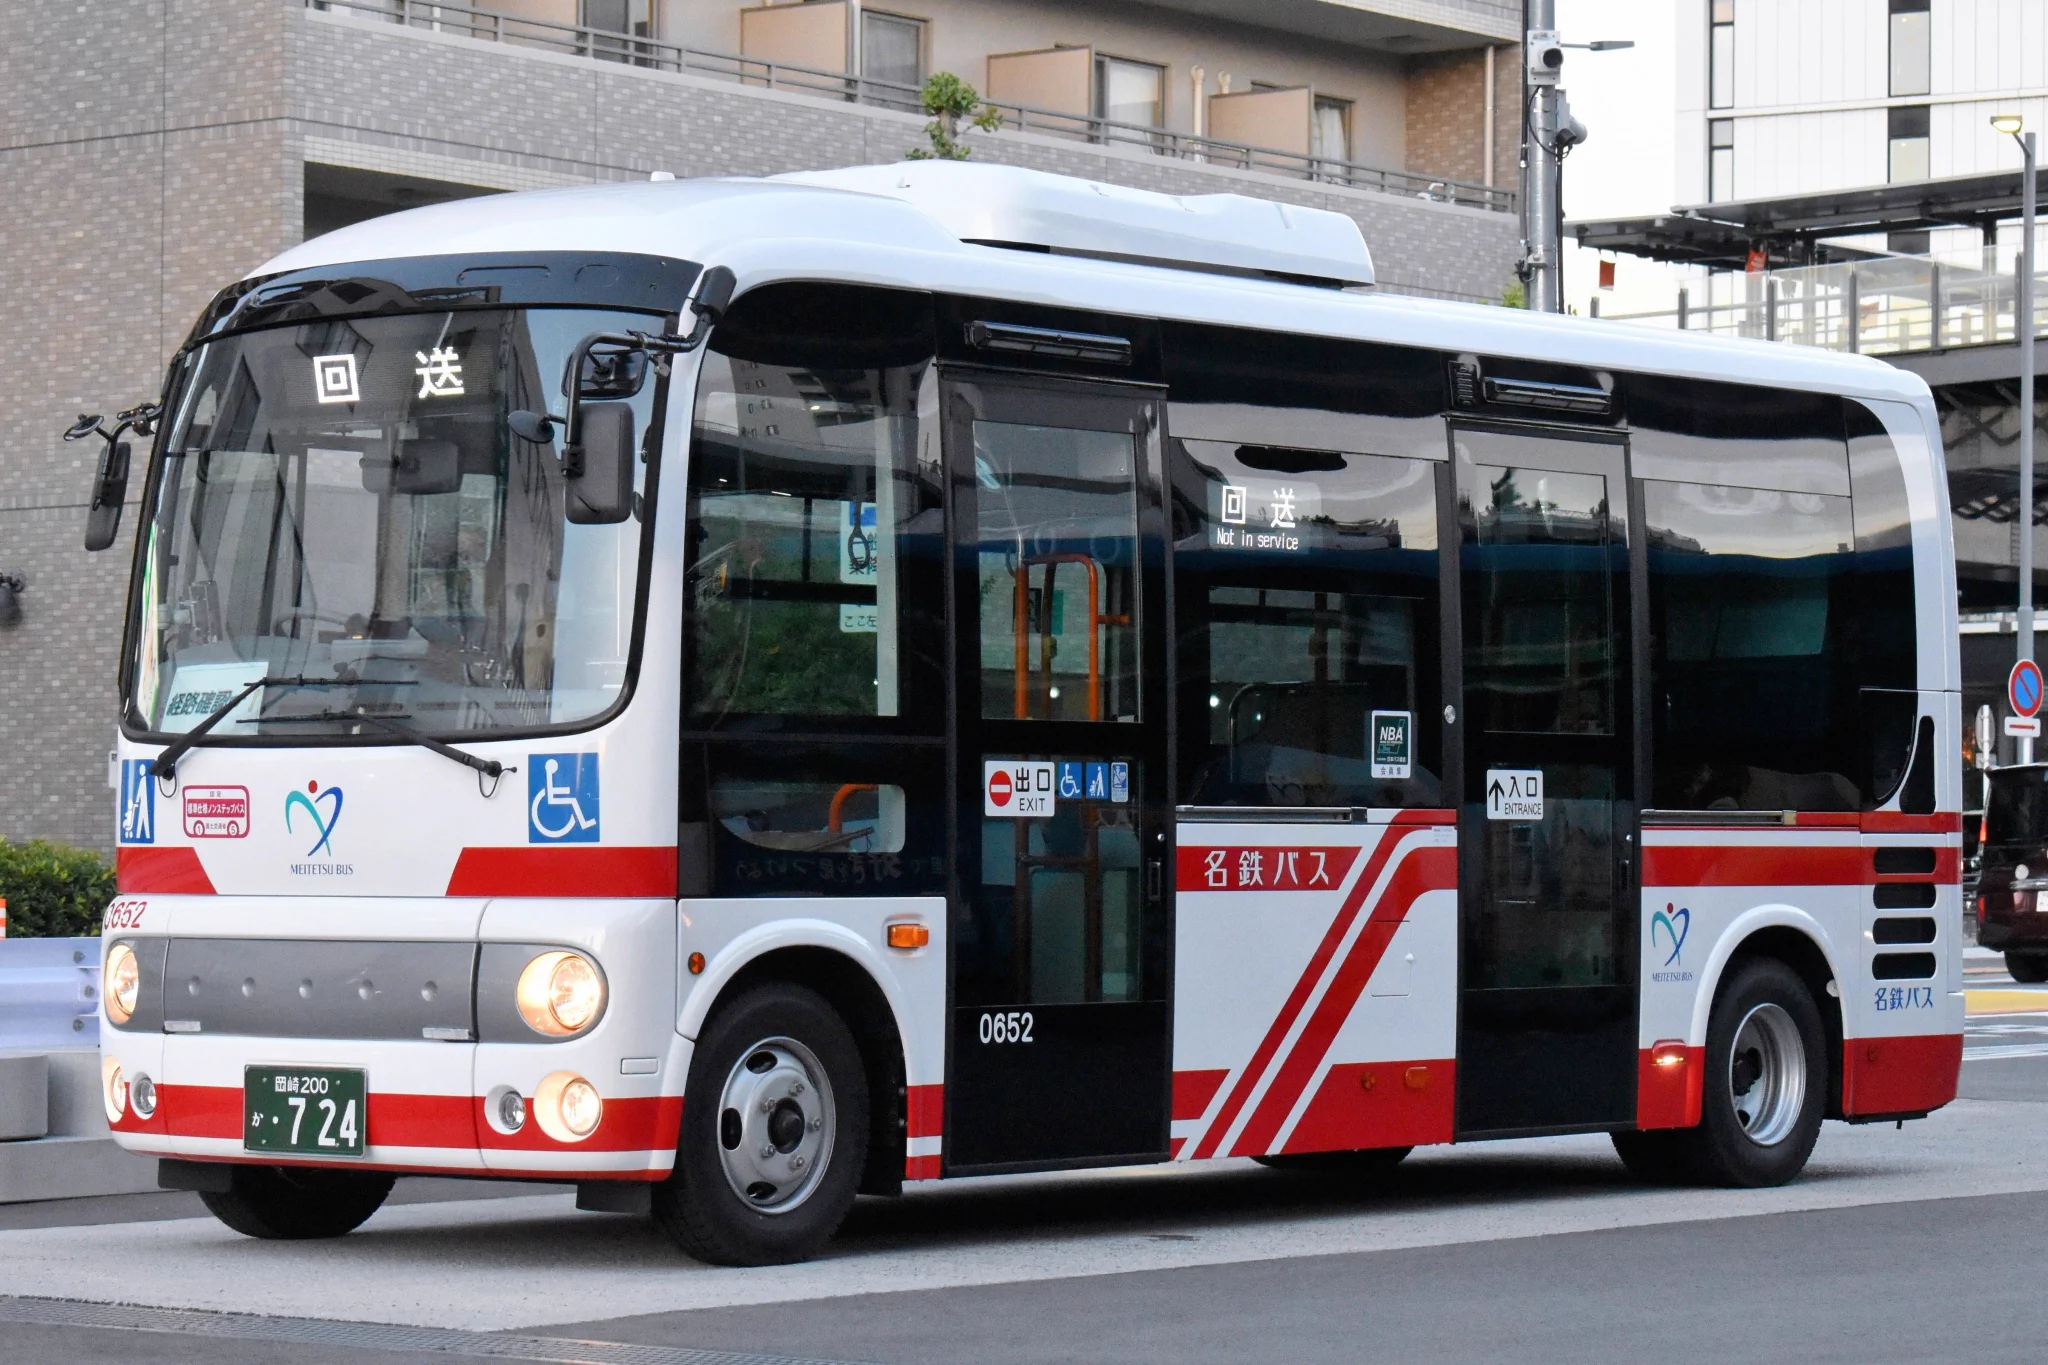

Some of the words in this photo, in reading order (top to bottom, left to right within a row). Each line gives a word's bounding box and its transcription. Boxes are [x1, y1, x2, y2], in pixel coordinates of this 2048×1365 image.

[313, 346, 465, 404] 回送
[1222, 485, 1296, 528] 回送
[1217, 527, 1235, 545] Not
[1241, 529, 1253, 547] in
[1257, 532, 1299, 550] service
[1380, 726, 1403, 741] NBA
[1015, 766, 1051, 792] 出口
[1509, 776, 1537, 798] 入口
[1019, 797, 1046, 812] EXIT
[1504, 802, 1542, 816] ENTRANCE
[290, 863, 334, 875] MEITETSU
[335, 863, 354, 875] BUS
[1204, 850, 1329, 887] 名鉄バス
[104, 901, 148, 930] 0652
[1874, 986, 1934, 1011] 名鉄バス
[979, 1011, 1034, 1044] 0652
